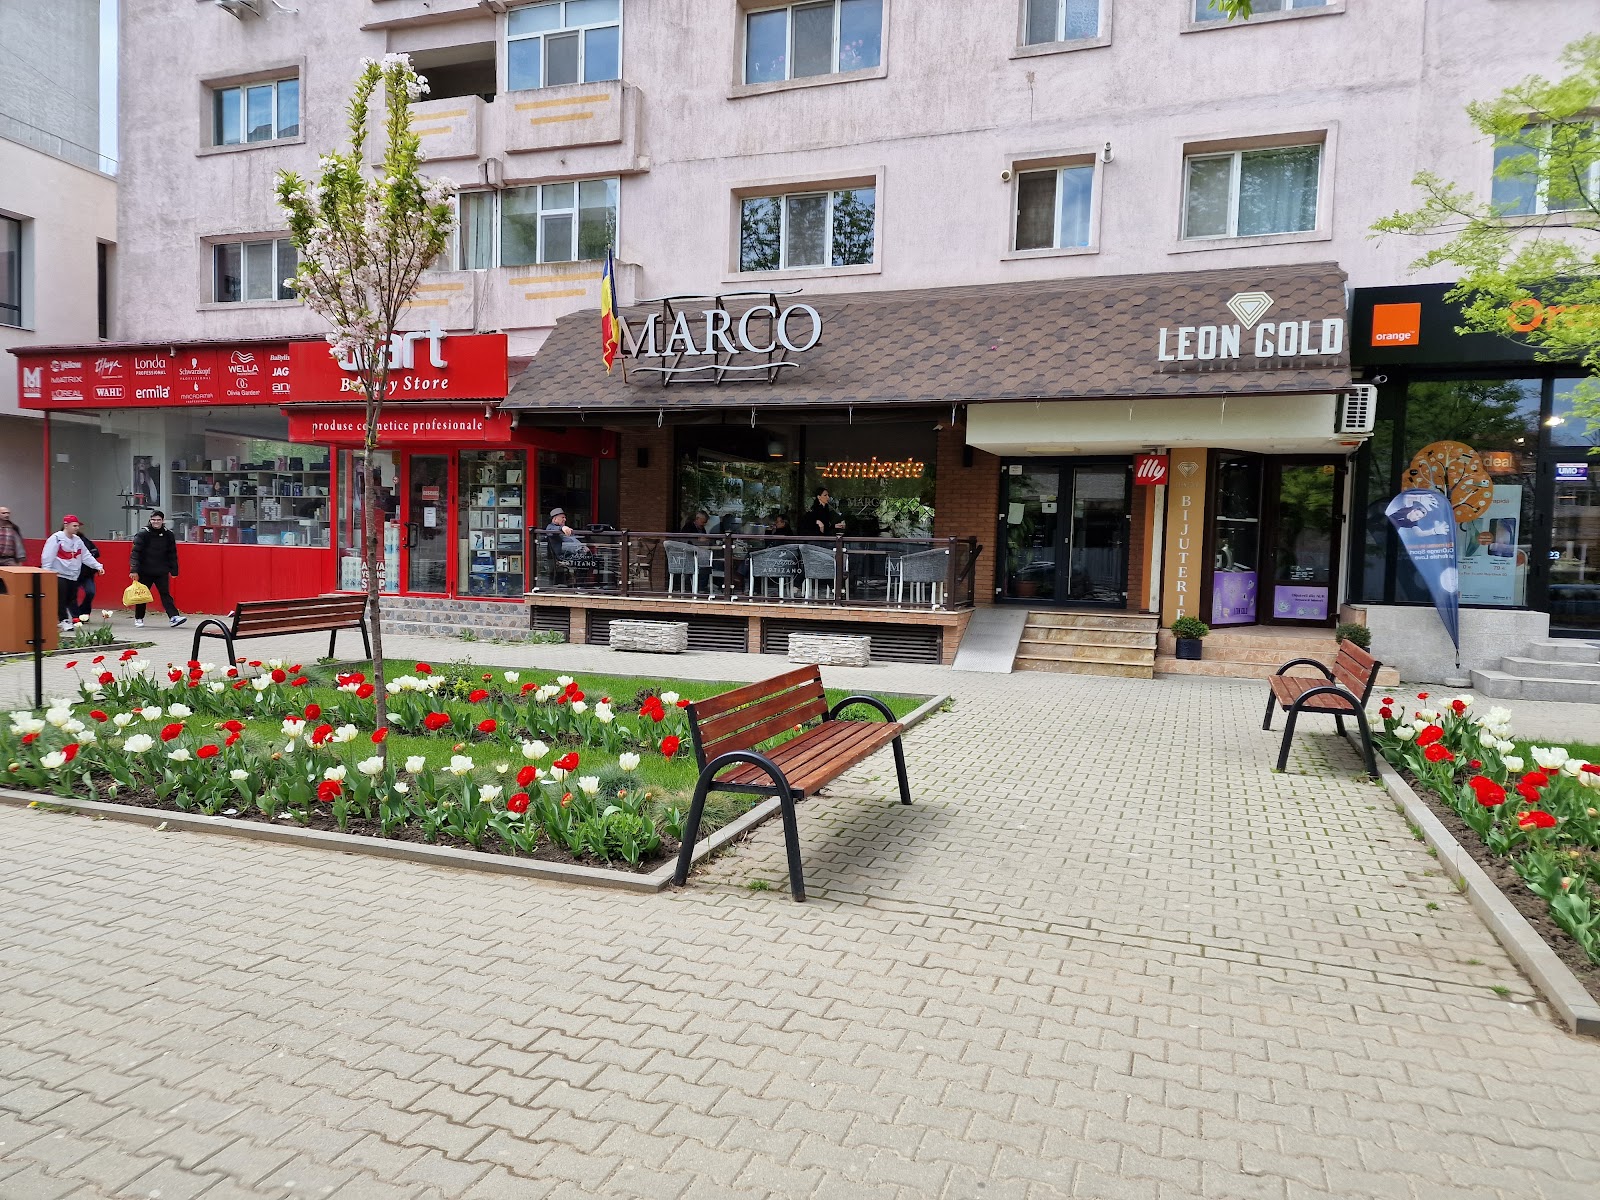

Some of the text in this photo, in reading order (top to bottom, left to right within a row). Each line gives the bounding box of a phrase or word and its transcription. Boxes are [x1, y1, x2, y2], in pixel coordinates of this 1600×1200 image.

[611, 303, 822, 358] MARCO
[1376, 332, 1411, 341] orange
[1158, 318, 1344, 361] LEON GOLD
[135, 354, 165, 369] Londa
[228, 364, 259, 373] WELLA
[179, 367, 211, 376] Schwarzkopf
[272, 367, 290, 377] JAG
[403, 375, 449, 391] Store
[96, 387, 122, 397] WAHL
[135, 384, 170, 399] ermila
[312, 419, 353, 434] produse
[412, 418, 483, 435] profesionale
[1137, 458, 1166, 482] illy
